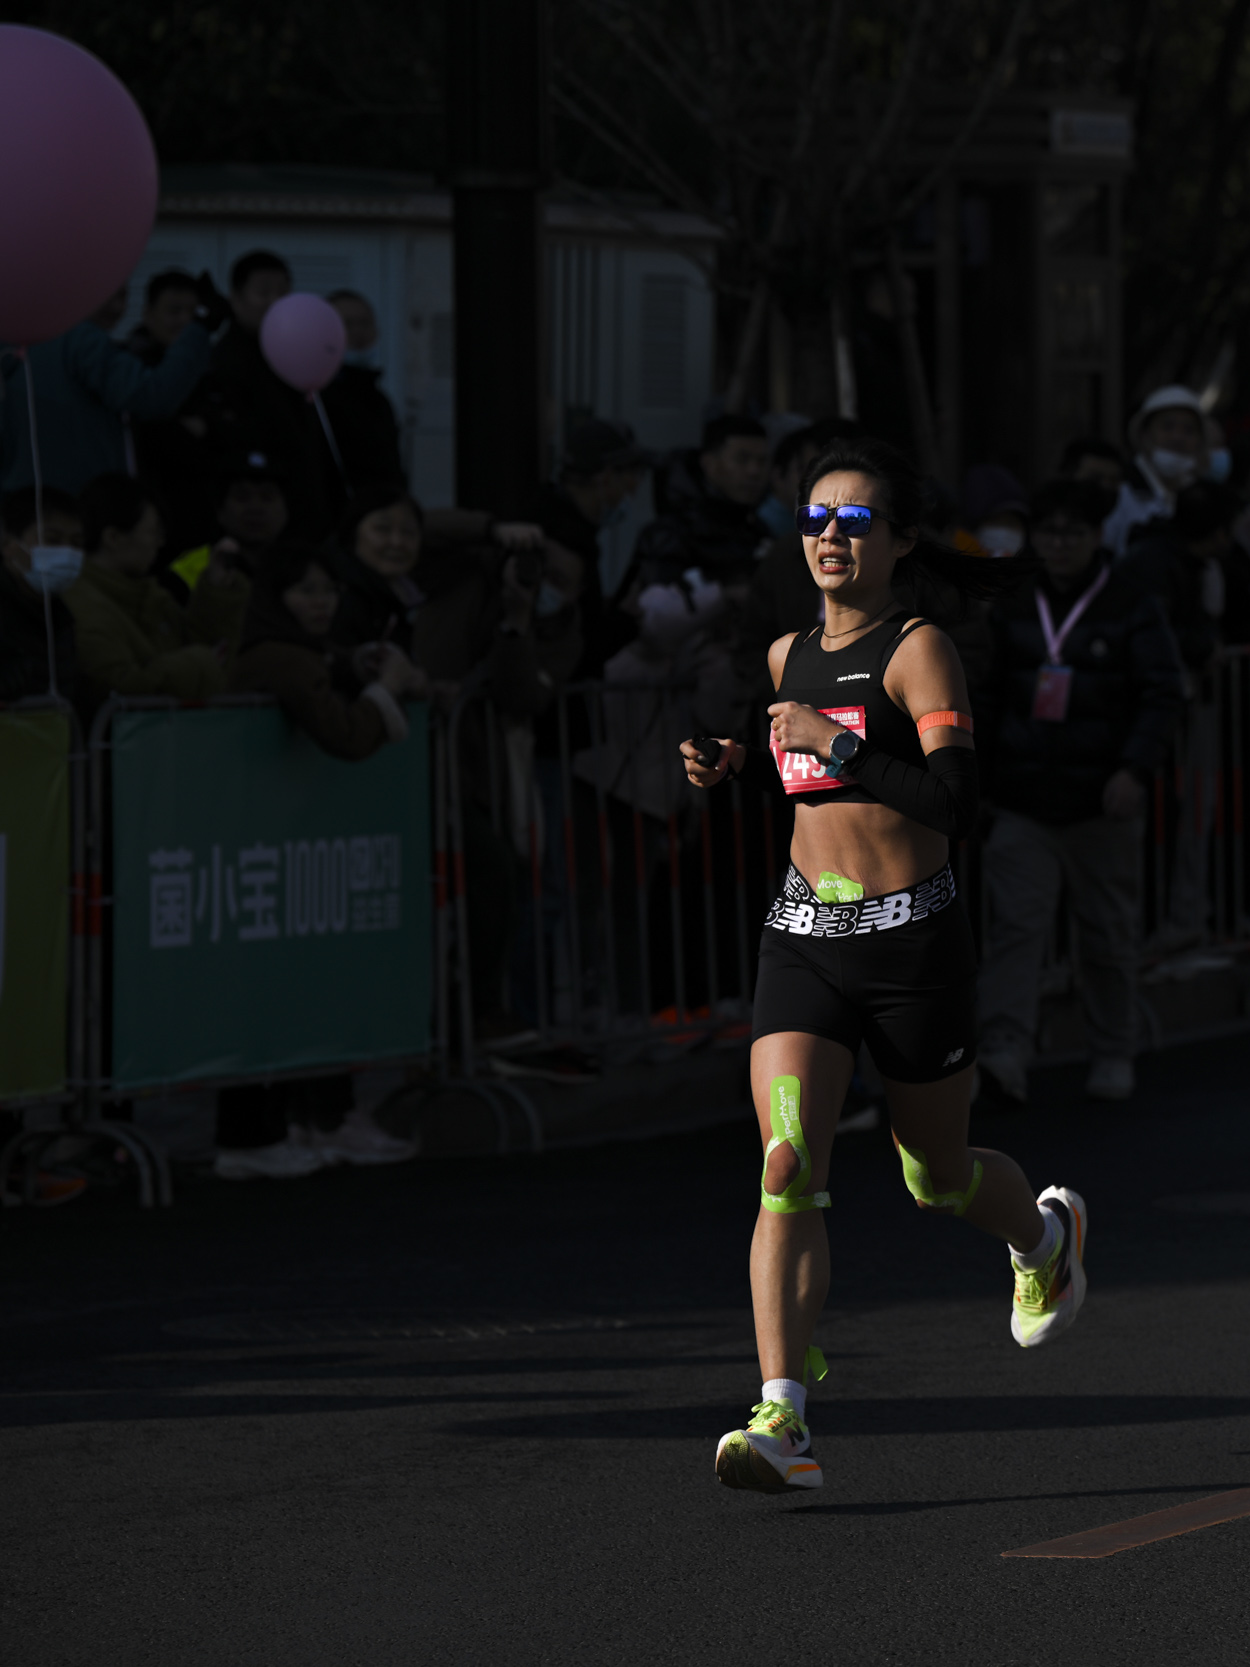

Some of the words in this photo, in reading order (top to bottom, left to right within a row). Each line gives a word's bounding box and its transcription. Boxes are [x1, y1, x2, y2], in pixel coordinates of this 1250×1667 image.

[771, 901, 815, 935] NB
[812, 905, 859, 938] NB
[855, 892, 912, 935] NB
